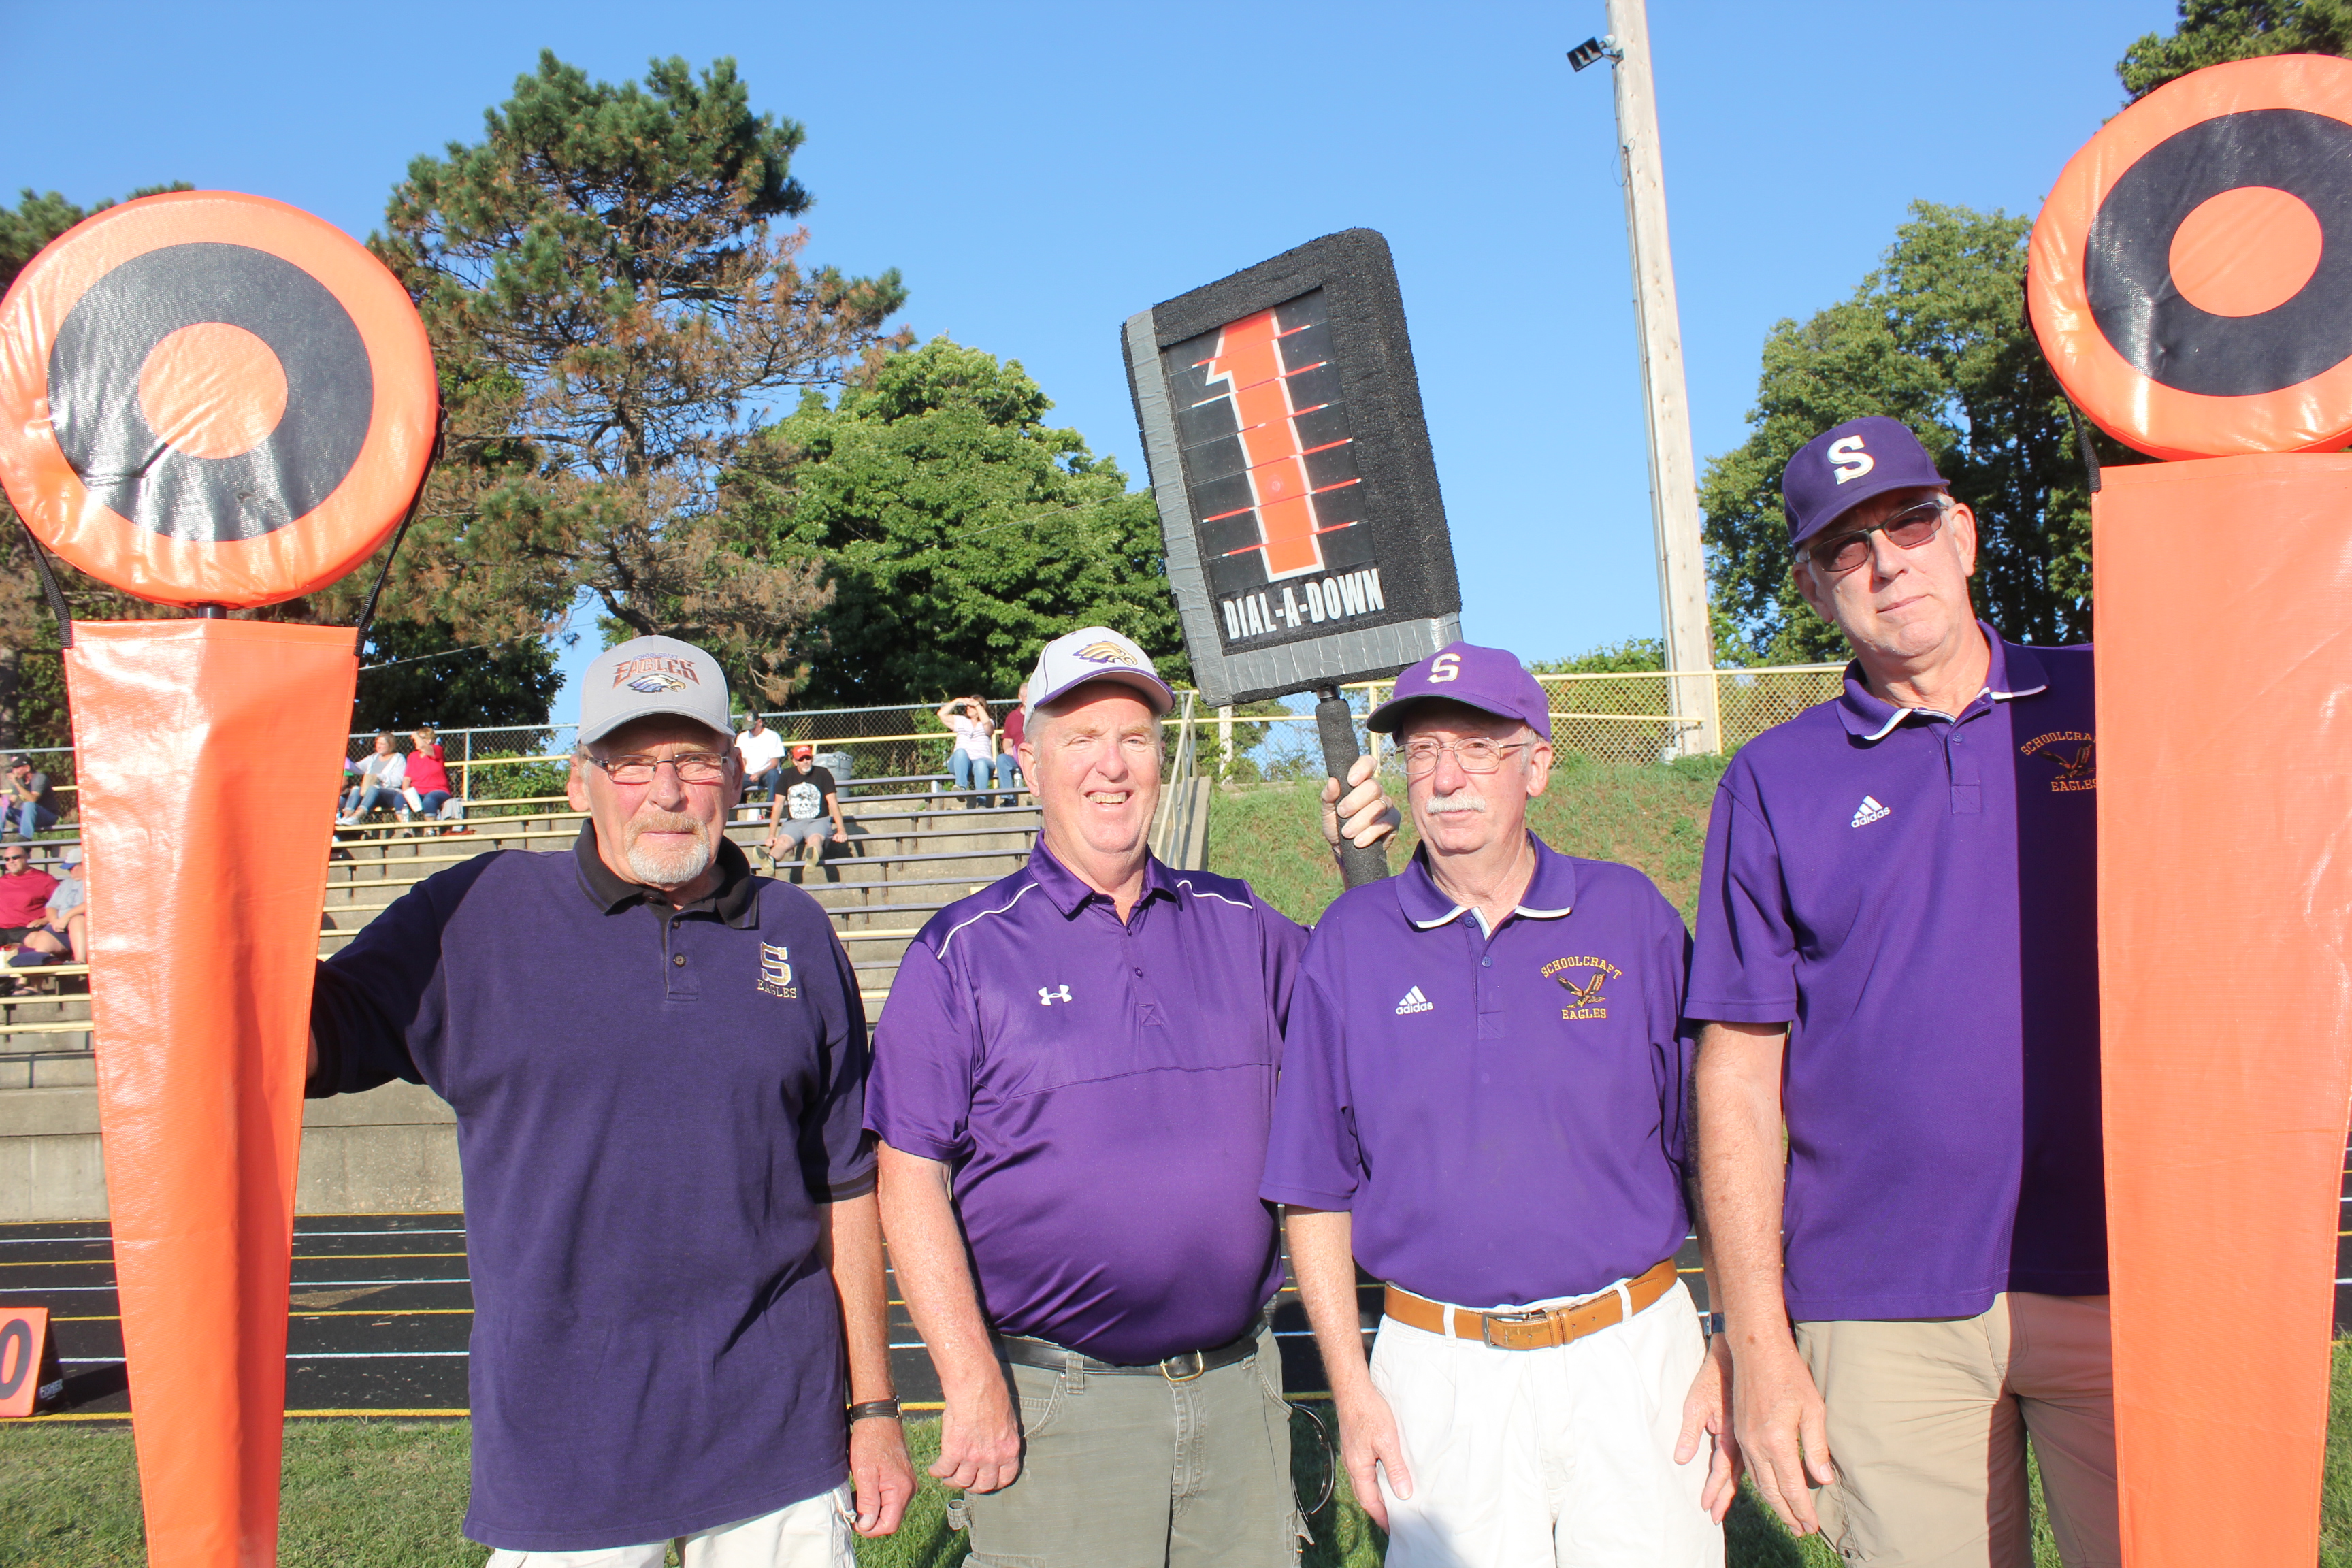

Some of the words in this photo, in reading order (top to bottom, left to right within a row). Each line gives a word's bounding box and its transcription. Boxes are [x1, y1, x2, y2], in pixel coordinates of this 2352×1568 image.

[1205, 306, 1325, 582] 1
[1827, 434, 1874, 485] S
[1222, 568, 1384, 640] DIAL-A-DOWN
[633, 652, 679, 661] SCHOOLCRAFT
[1426, 653, 1461, 684] S
[612, 657, 700, 690] EAGLES
[2020, 731, 2096, 755] SCHOOLCRA
[1850, 806, 1891, 828] adidas
[760, 941, 791, 986] S
[1541, 956, 1622, 980] SCHOOLCRAFT
[757, 979, 797, 999] EAGLES
[1395, 1001, 1433, 1015] adidas
[1561, 1008, 1607, 1020] EAGLES
[0, 1318, 32, 1400] 0
